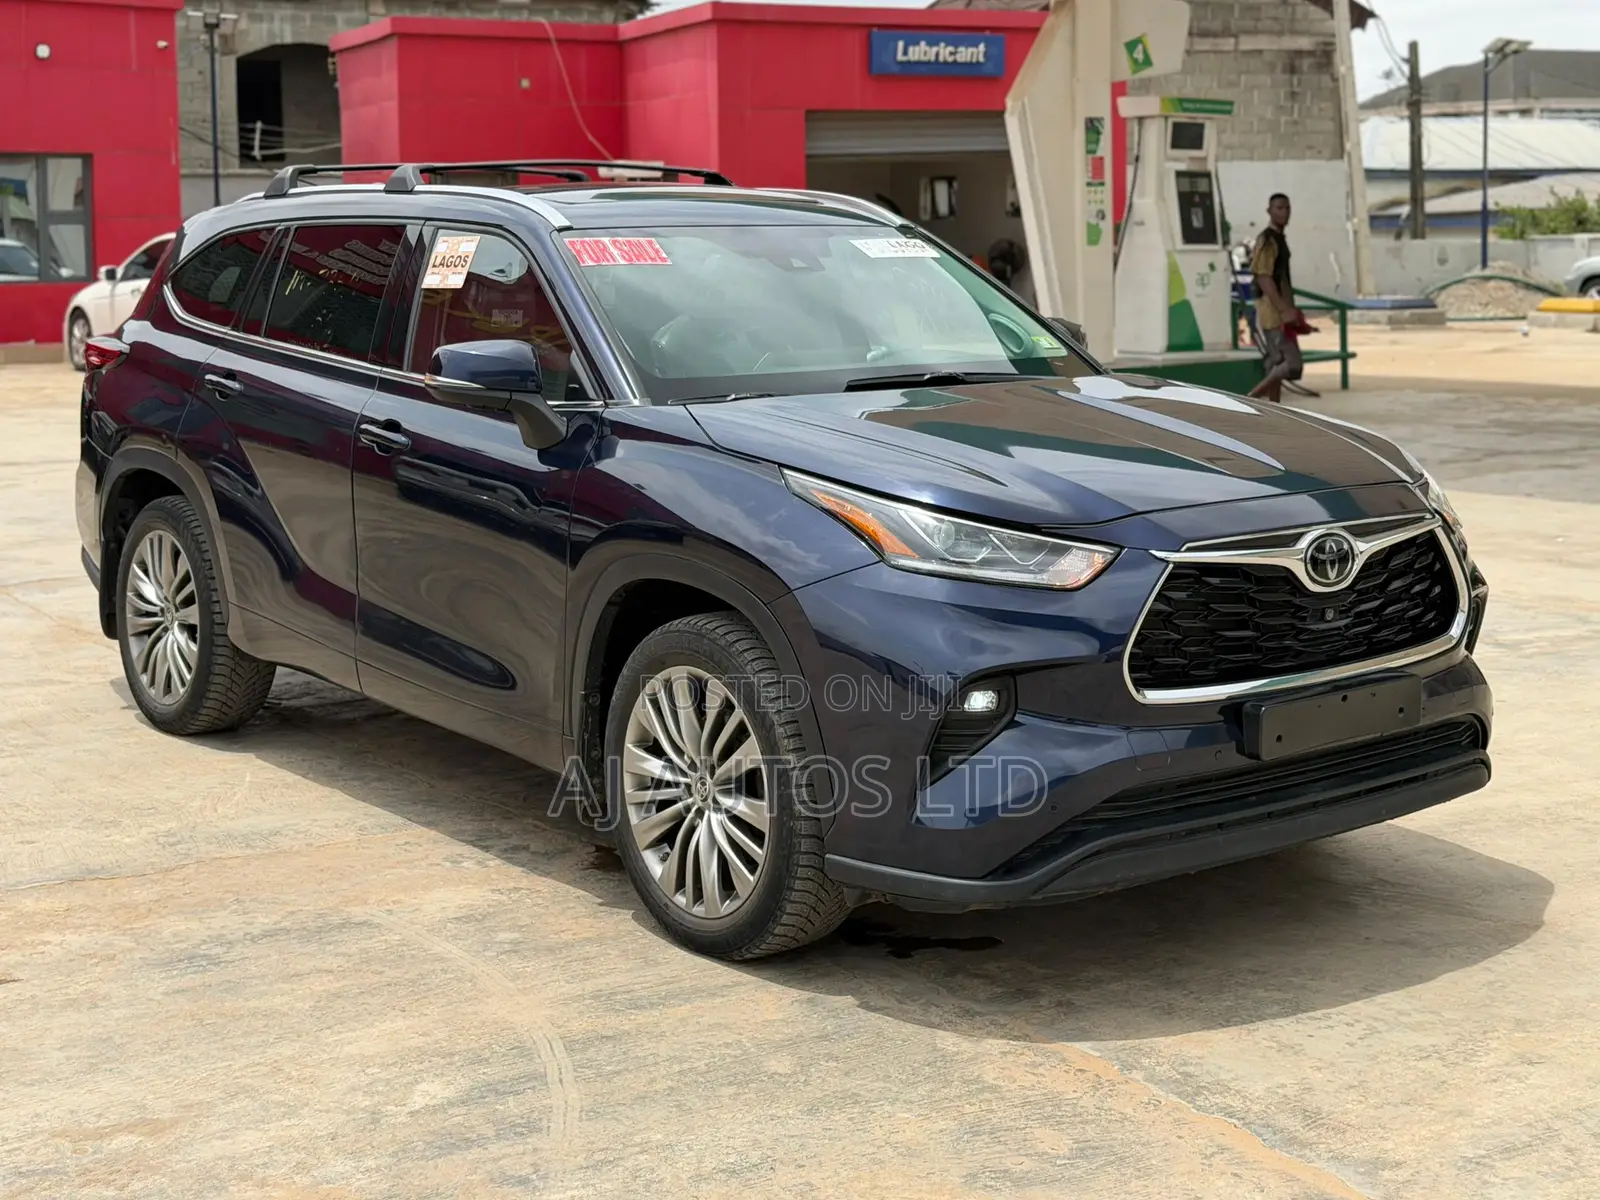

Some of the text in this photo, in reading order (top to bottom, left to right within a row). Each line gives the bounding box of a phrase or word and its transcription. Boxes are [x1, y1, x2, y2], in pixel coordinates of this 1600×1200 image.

[896, 39, 986, 63] Lubricant
[1132, 43, 1145, 64] 4
[431, 254, 470, 269] LAGOS
[567, 238, 669, 265] FOR SALE
